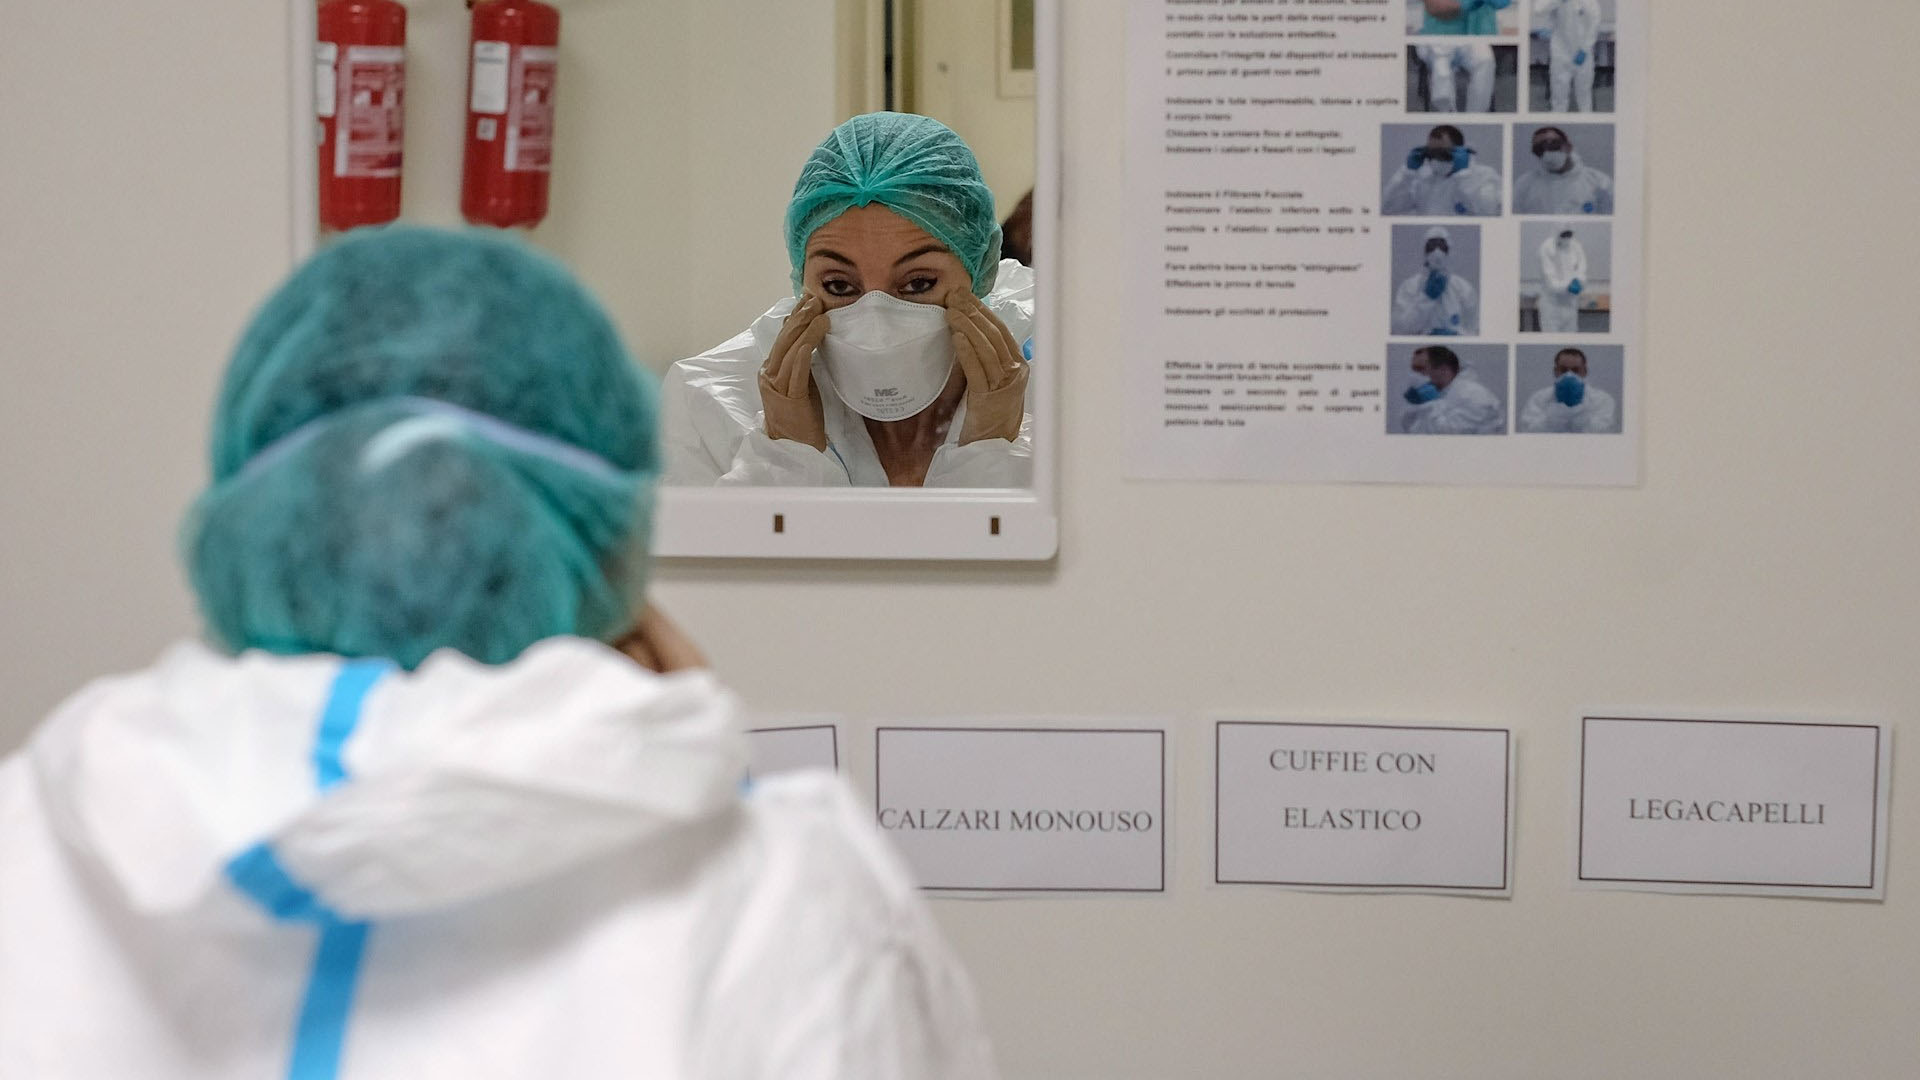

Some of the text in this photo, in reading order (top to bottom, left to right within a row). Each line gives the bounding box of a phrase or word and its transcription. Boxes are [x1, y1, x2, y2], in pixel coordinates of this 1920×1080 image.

[1269, 750, 1435, 773] CUFFIE CON
[879, 809, 1153, 831] CALZARI MONOUSO
[1285, 807, 1422, 830] ELASTICO
[1630, 799, 1824, 824] LEGACAPELLI
